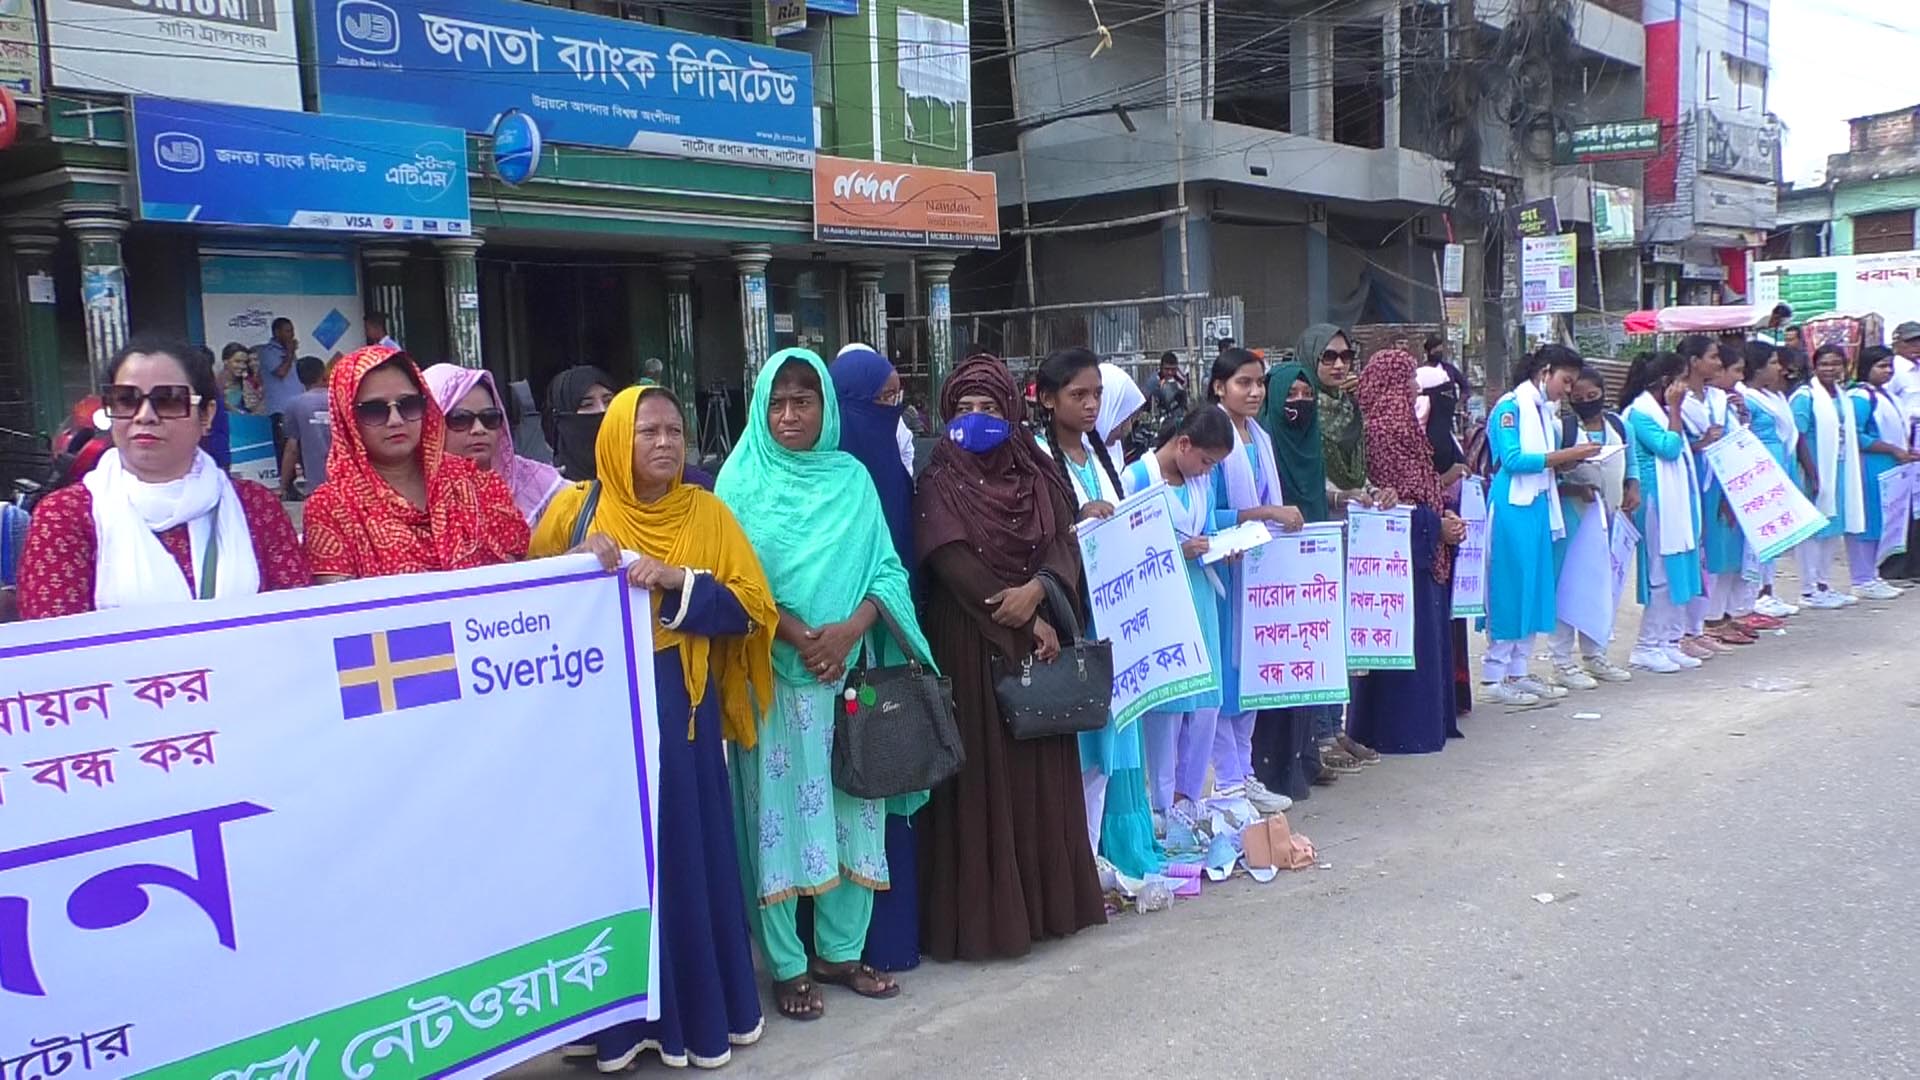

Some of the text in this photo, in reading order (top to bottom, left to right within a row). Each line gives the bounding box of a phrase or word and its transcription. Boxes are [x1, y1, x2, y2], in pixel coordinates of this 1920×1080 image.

[419, 13, 798, 105] জনতা ব্যাংক লিমিটেড
[215, 149, 367, 173] জনতা ব্যাংক লিমিটেড
[681, 137, 714, 153] নাটোর
[385, 163, 448, 188] এটিএম
[344, 216, 373, 228] VISA
[925, 200, 971, 213] Nandan
[1093, 546, 1176, 614] নারোদ নদীর
[1247, 573, 1339, 608] নারোদ নদীর
[466, 611, 550, 642] Sweden
[1120, 607, 1150, 643] দখল
[1254, 618, 1331, 651] দখল-দূষণ
[1372, 628, 1392, 649] কর
[472, 643, 604, 694] Sverige
[1152, 643, 1187, 672] কর
[1258, 663, 1285, 686] বন্ধ
[1289, 661, 1315, 682] কর
[125, 668, 214, 710] কর
[22, 748, 119, 793] বন্ধ
[130, 731, 220, 773] কর
[340, 927, 614, 1080] নেটওয়ার্ক
